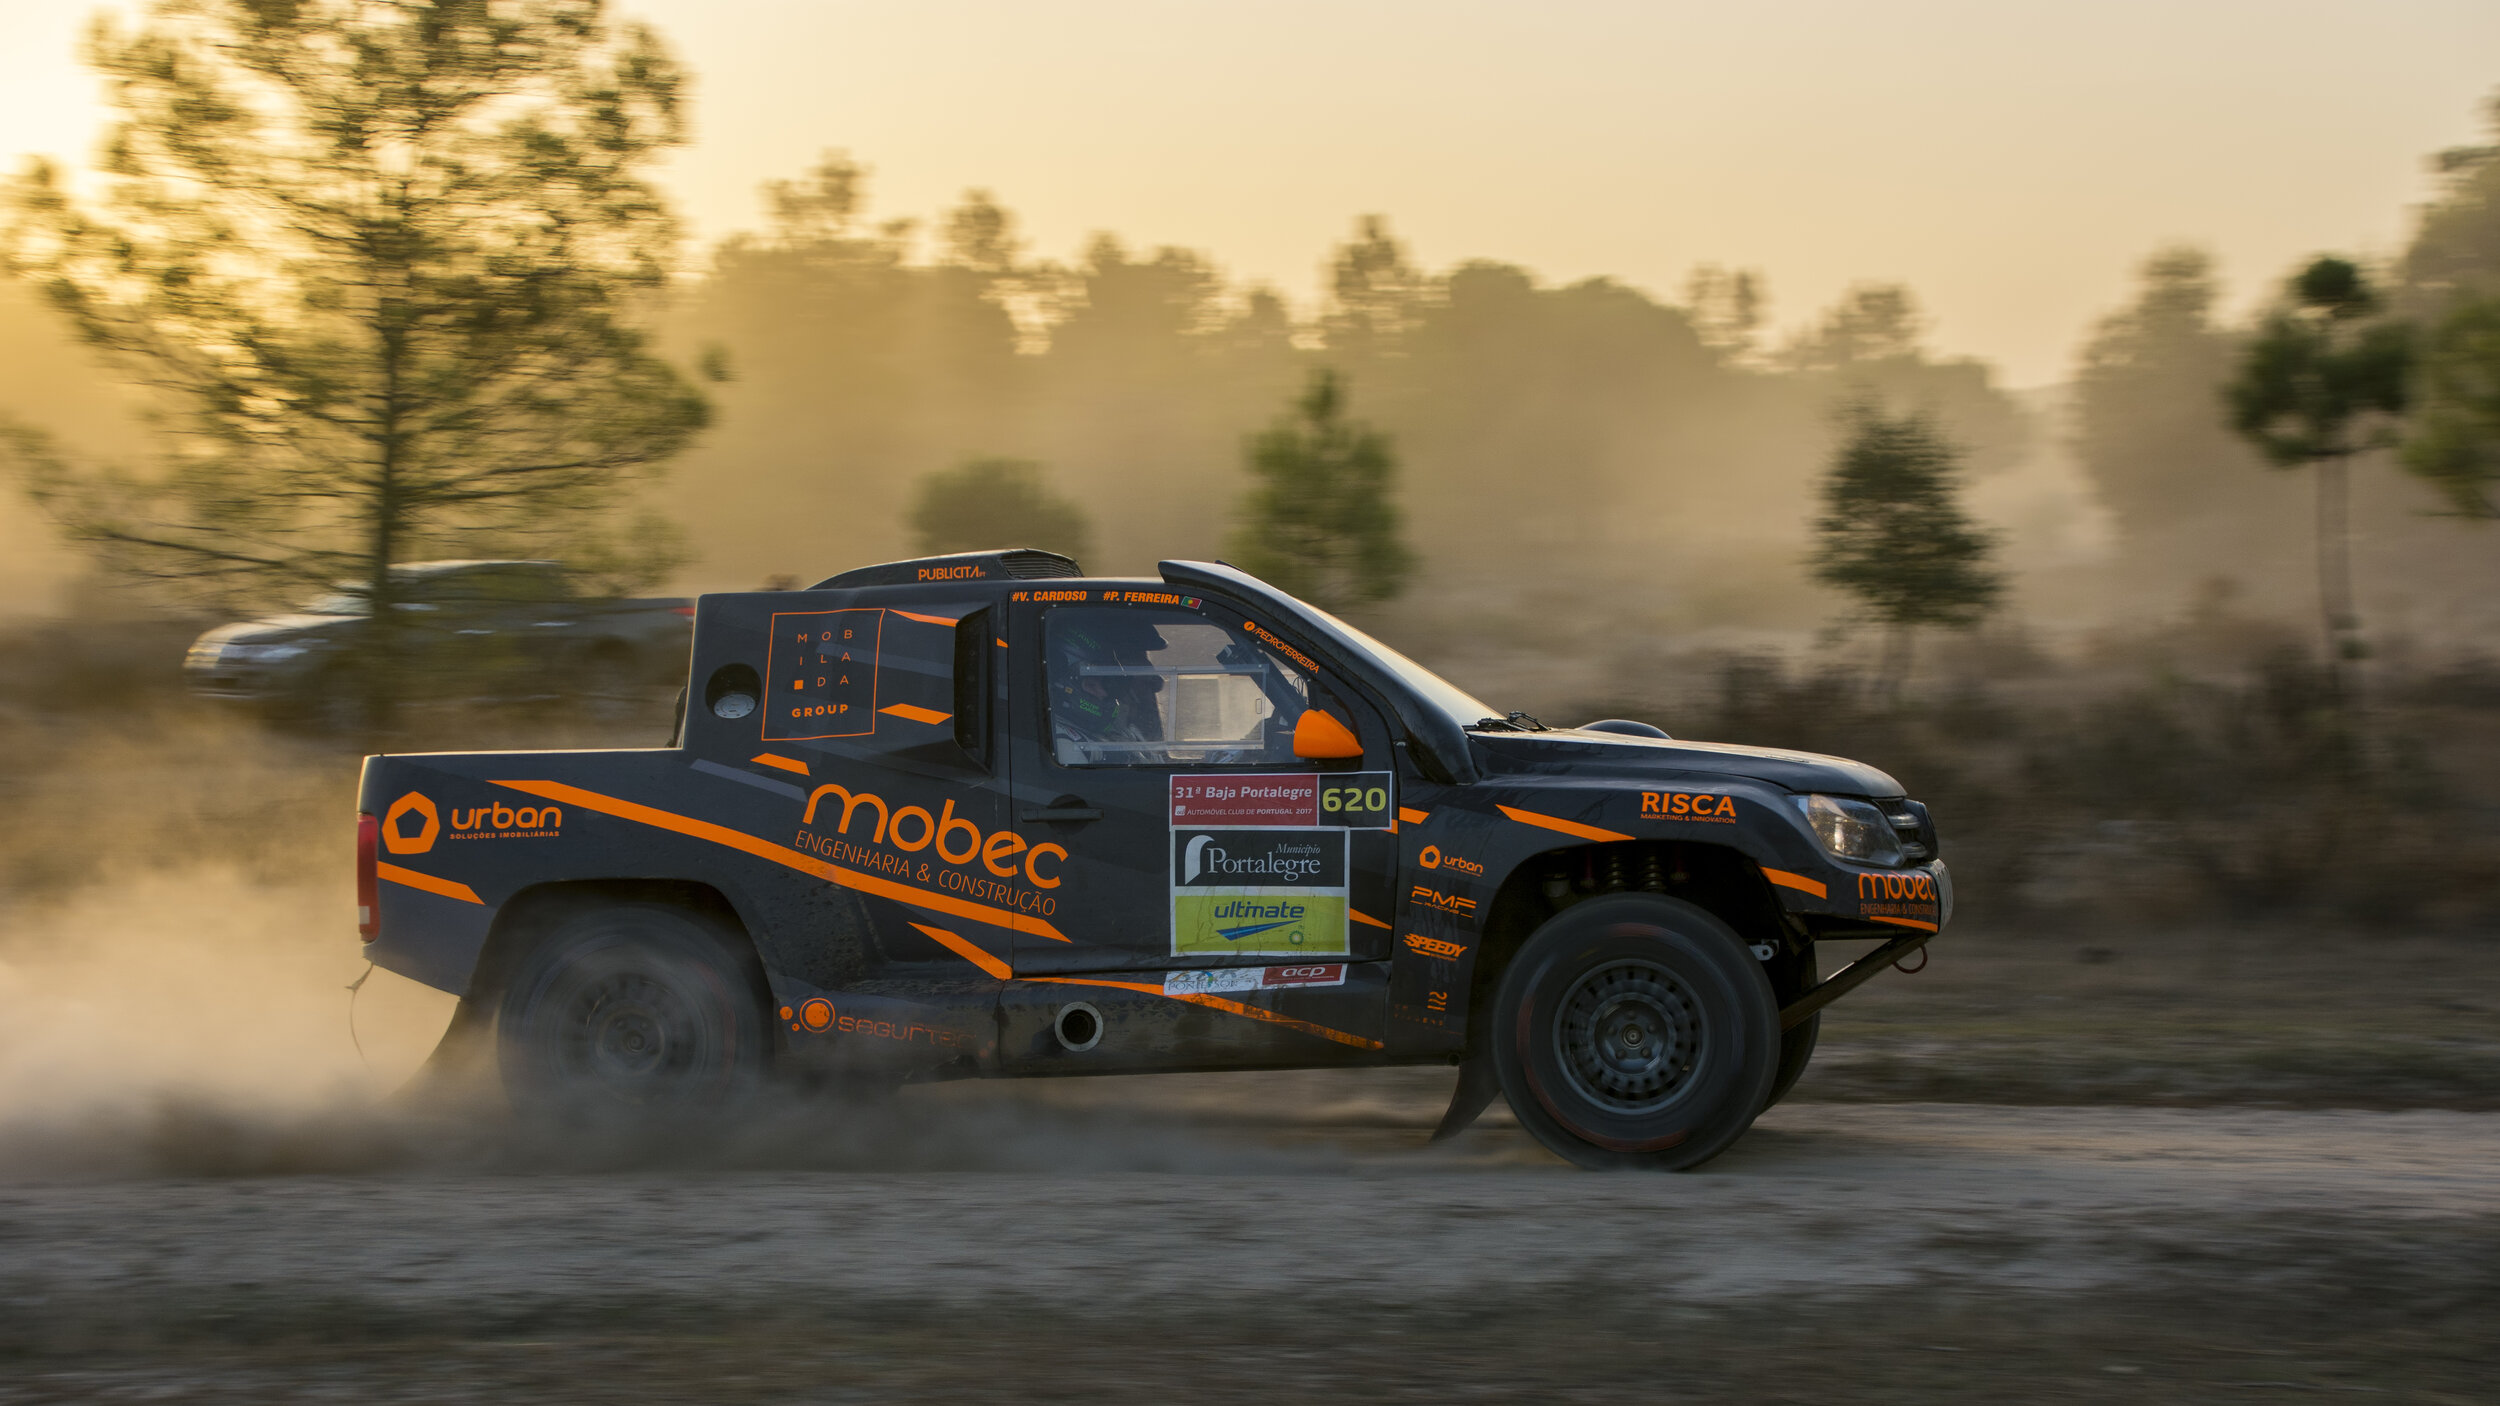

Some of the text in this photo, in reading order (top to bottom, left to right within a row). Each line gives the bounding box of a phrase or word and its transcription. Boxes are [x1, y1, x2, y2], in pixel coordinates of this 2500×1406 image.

[1012, 591, 1087, 602] #V. CARDOSO
[1103, 591, 1180, 605] #P. FERREIRA
[791, 703, 849, 718] GROUP
[1205, 786, 1236, 800] Baja
[1240, 786, 1312, 800] Portalegre
[1322, 788, 1386, 812] 620
[1641, 791, 1736, 817] RISCA
[451, 801, 562, 830] urban
[1640, 813, 1683, 821] MARKETING
[1691, 815, 1736, 824] INNOVATION
[802, 783, 1069, 889] mobec
[795, 830, 1056, 916] ENGENHARIA & CONSTRUÇÃO
[1207, 847, 1321, 881] Portalegre
[1444, 855, 1483, 874] urban
[1411, 886, 1477, 909] PMF
[1214, 901, 1305, 919] ultimate
[1403, 933, 1468, 957] SPEEDY
[1281, 966, 1326, 978] acp
